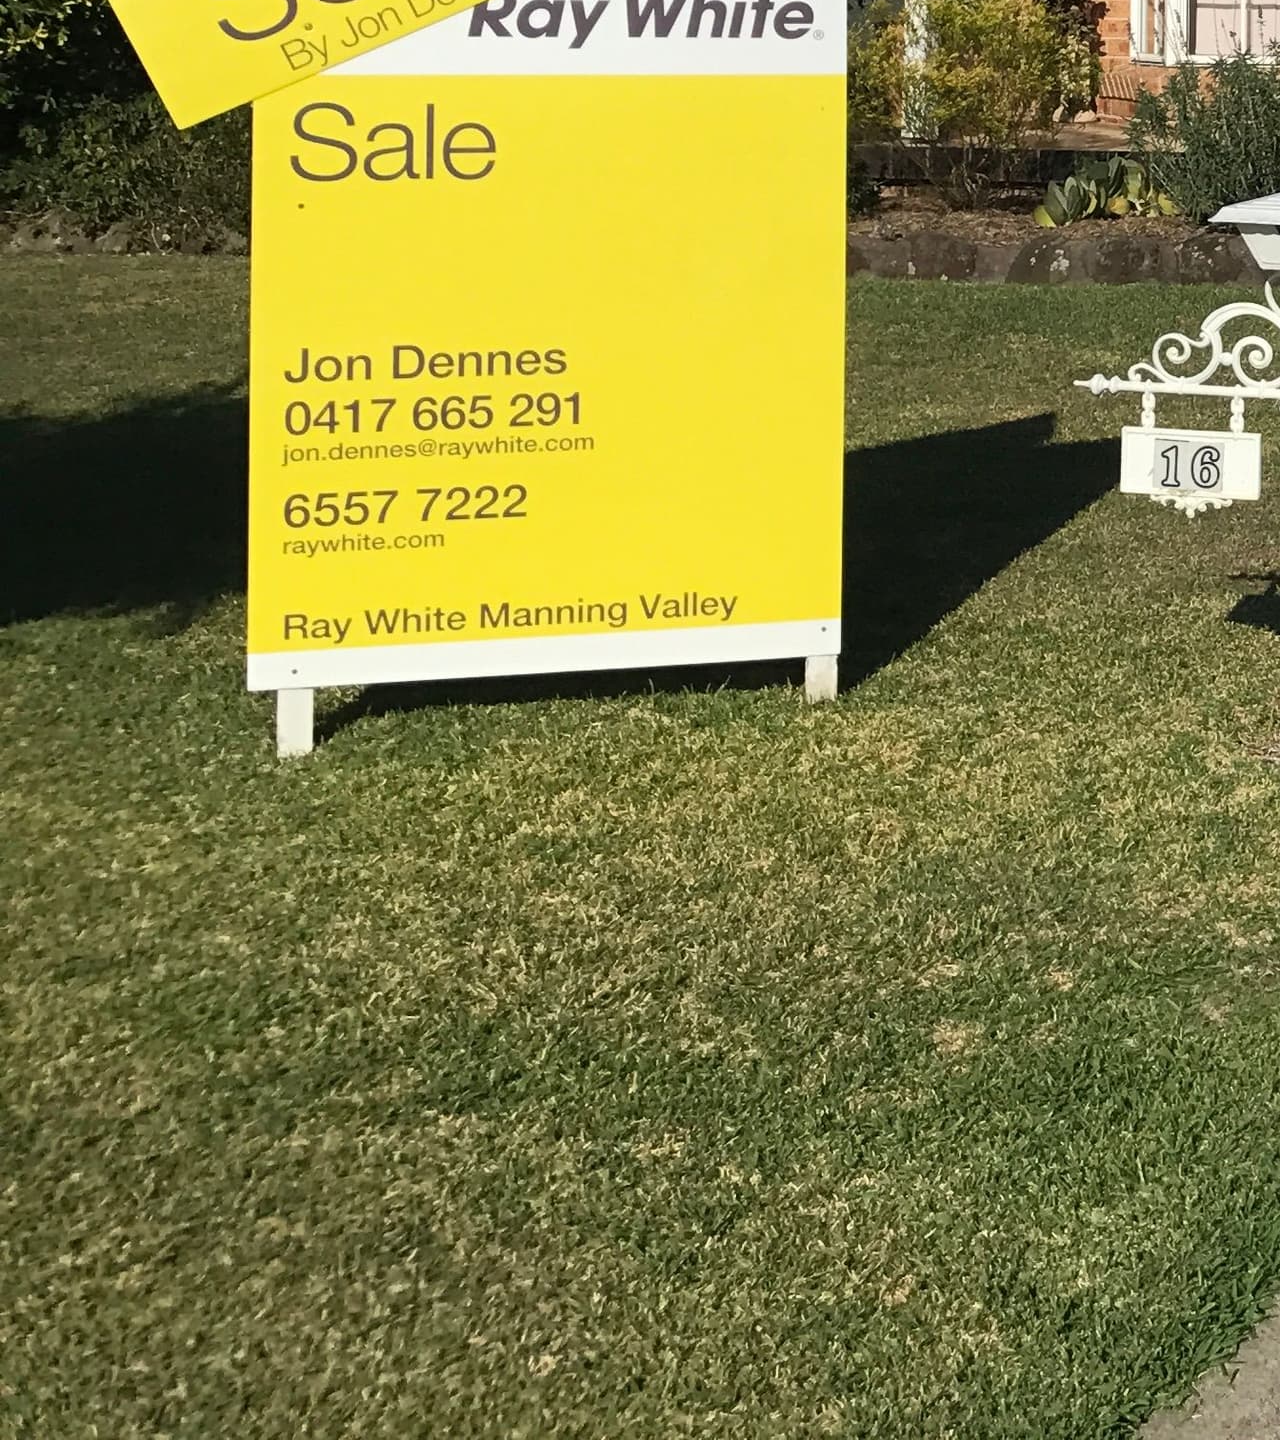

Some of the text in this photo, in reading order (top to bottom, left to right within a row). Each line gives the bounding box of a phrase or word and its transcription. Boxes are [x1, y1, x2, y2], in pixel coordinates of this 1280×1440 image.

[280, 35, 329, 71] By
[340, 6, 403, 49] Jon
[289, 101, 497, 183] Sale
[283, 344, 568, 384] Jon Dennes
[284, 391, 582, 436] 0417 665 291
[281, 434, 595, 467] jon.dennes@raywhite.com
[1160, 444, 1222, 489] 16
[283, 484, 529, 529] 6557 7222
[282, 532, 446, 559] raywhite.com
[283, 590, 739, 645] Ray White Manning Valley
